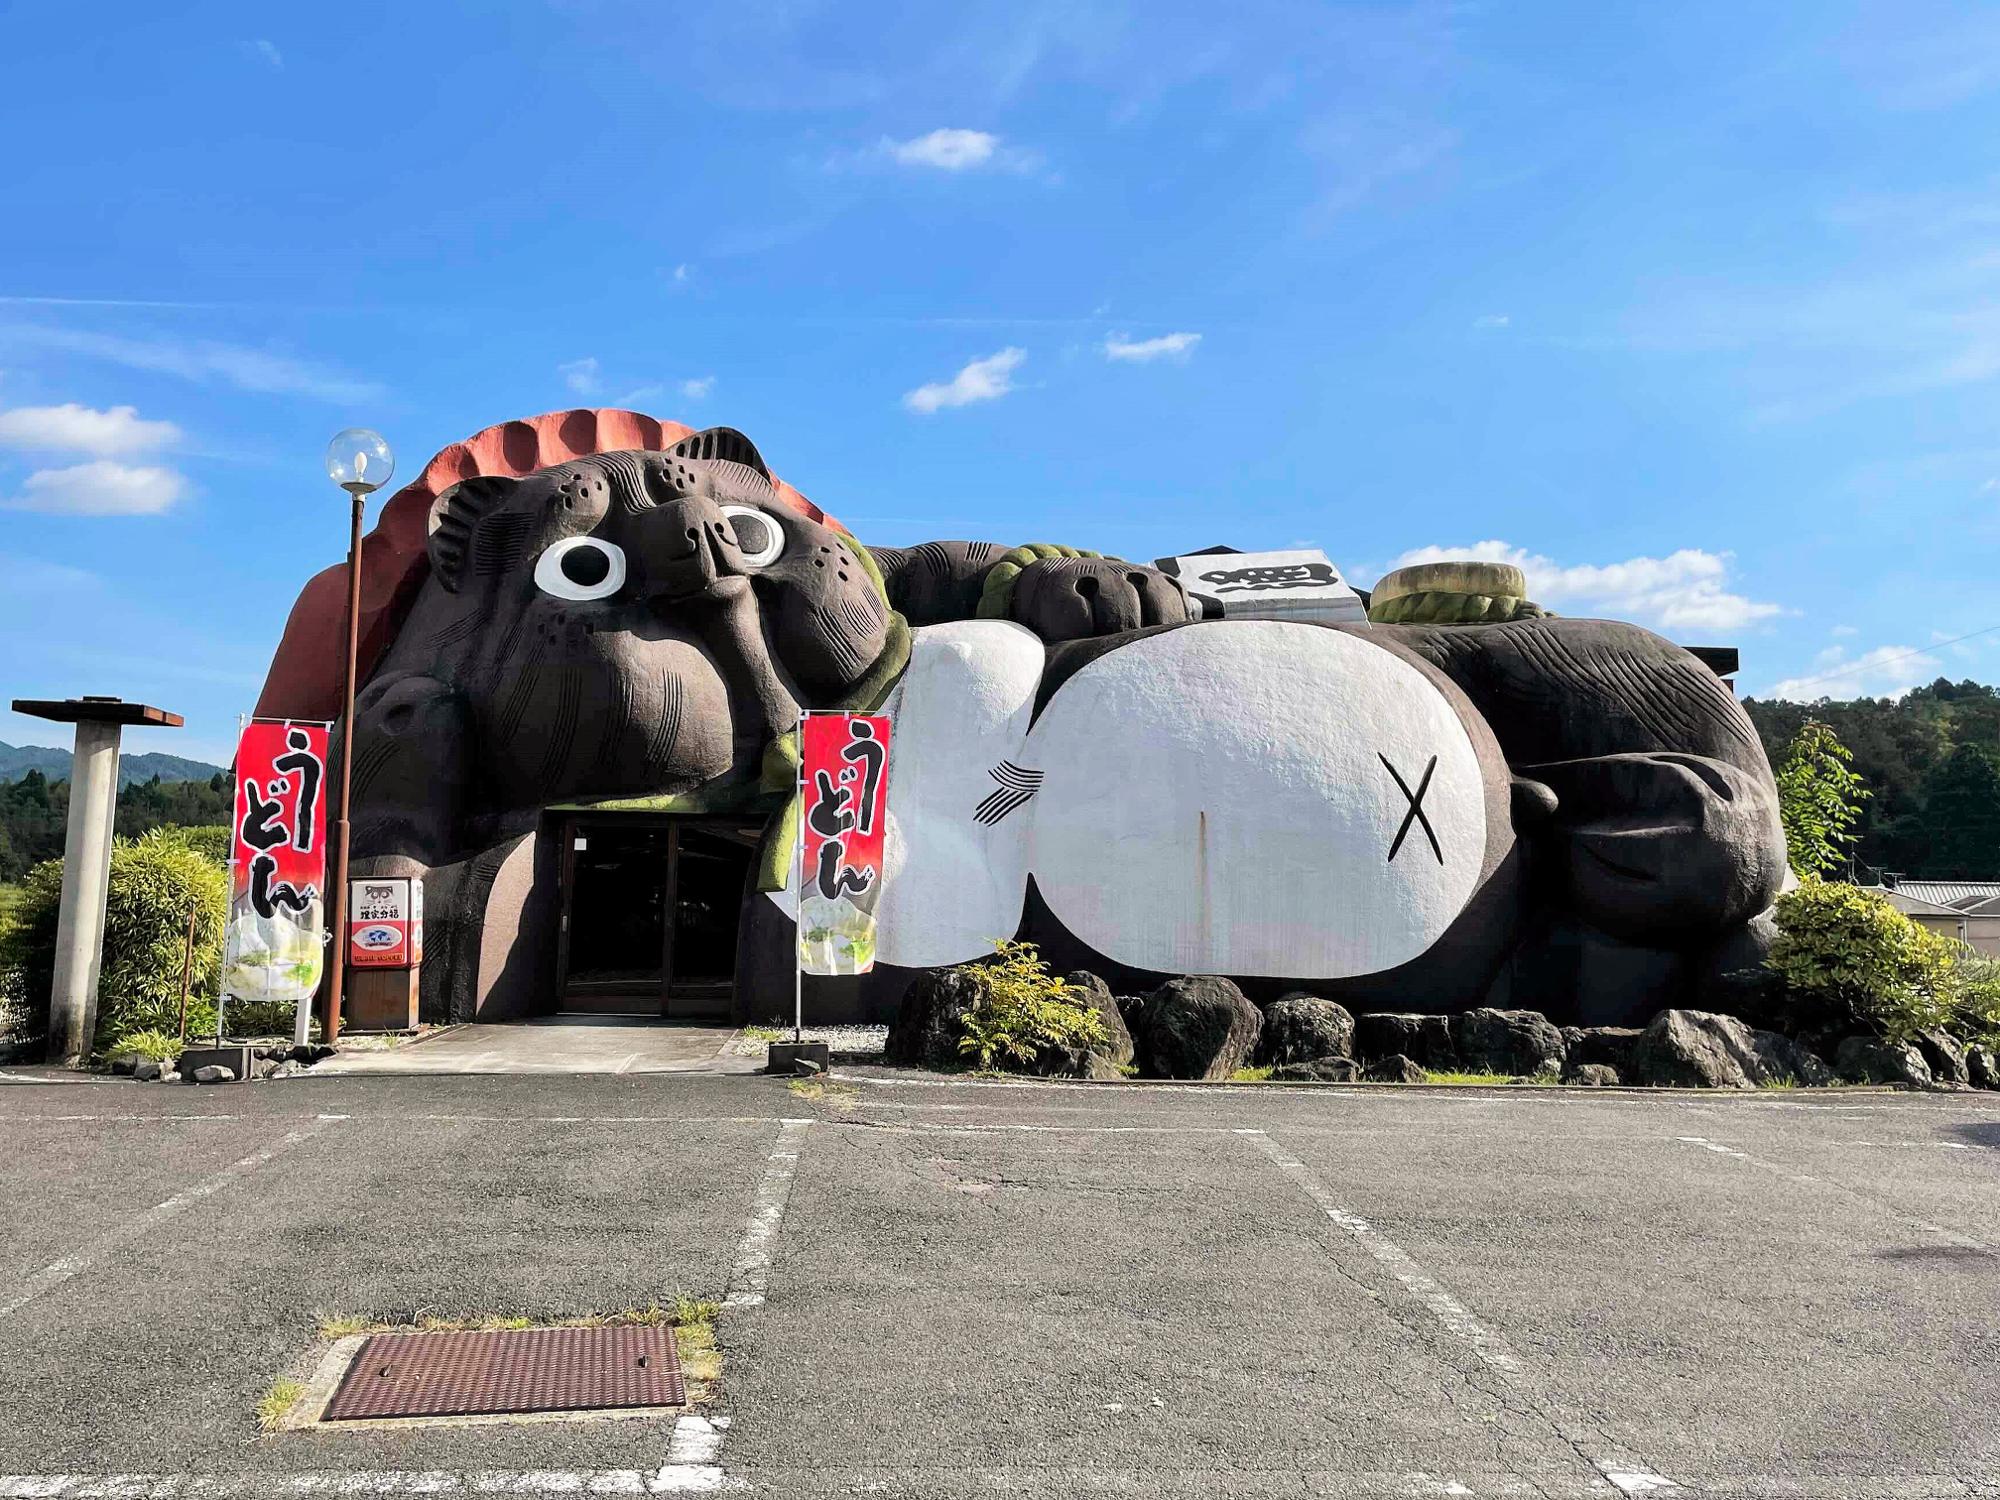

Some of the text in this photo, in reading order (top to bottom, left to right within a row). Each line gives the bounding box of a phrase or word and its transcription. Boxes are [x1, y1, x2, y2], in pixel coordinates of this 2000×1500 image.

[240, 727, 323, 919] うどん
[808, 719, 885, 899] うどん
